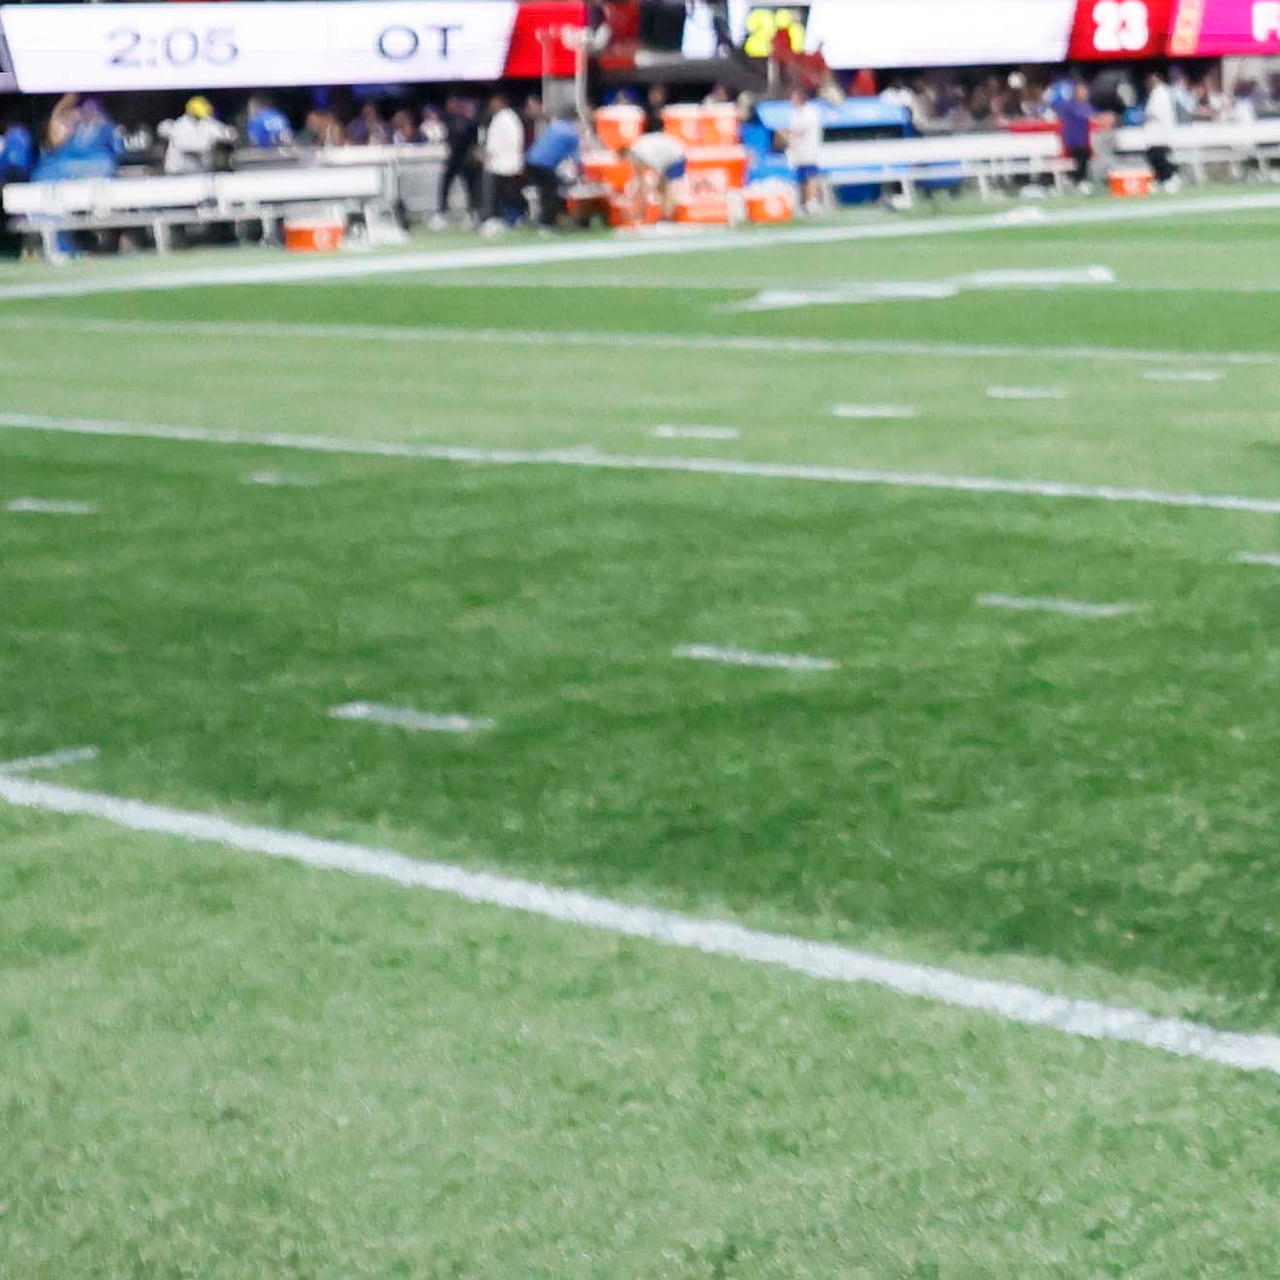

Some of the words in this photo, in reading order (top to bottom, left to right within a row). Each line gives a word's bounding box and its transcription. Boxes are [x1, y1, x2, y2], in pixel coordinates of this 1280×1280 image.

[106, 26, 241, 68] 2:05
[374, 24, 465, 61] OT
[1092, 0, 1150, 52] 23
